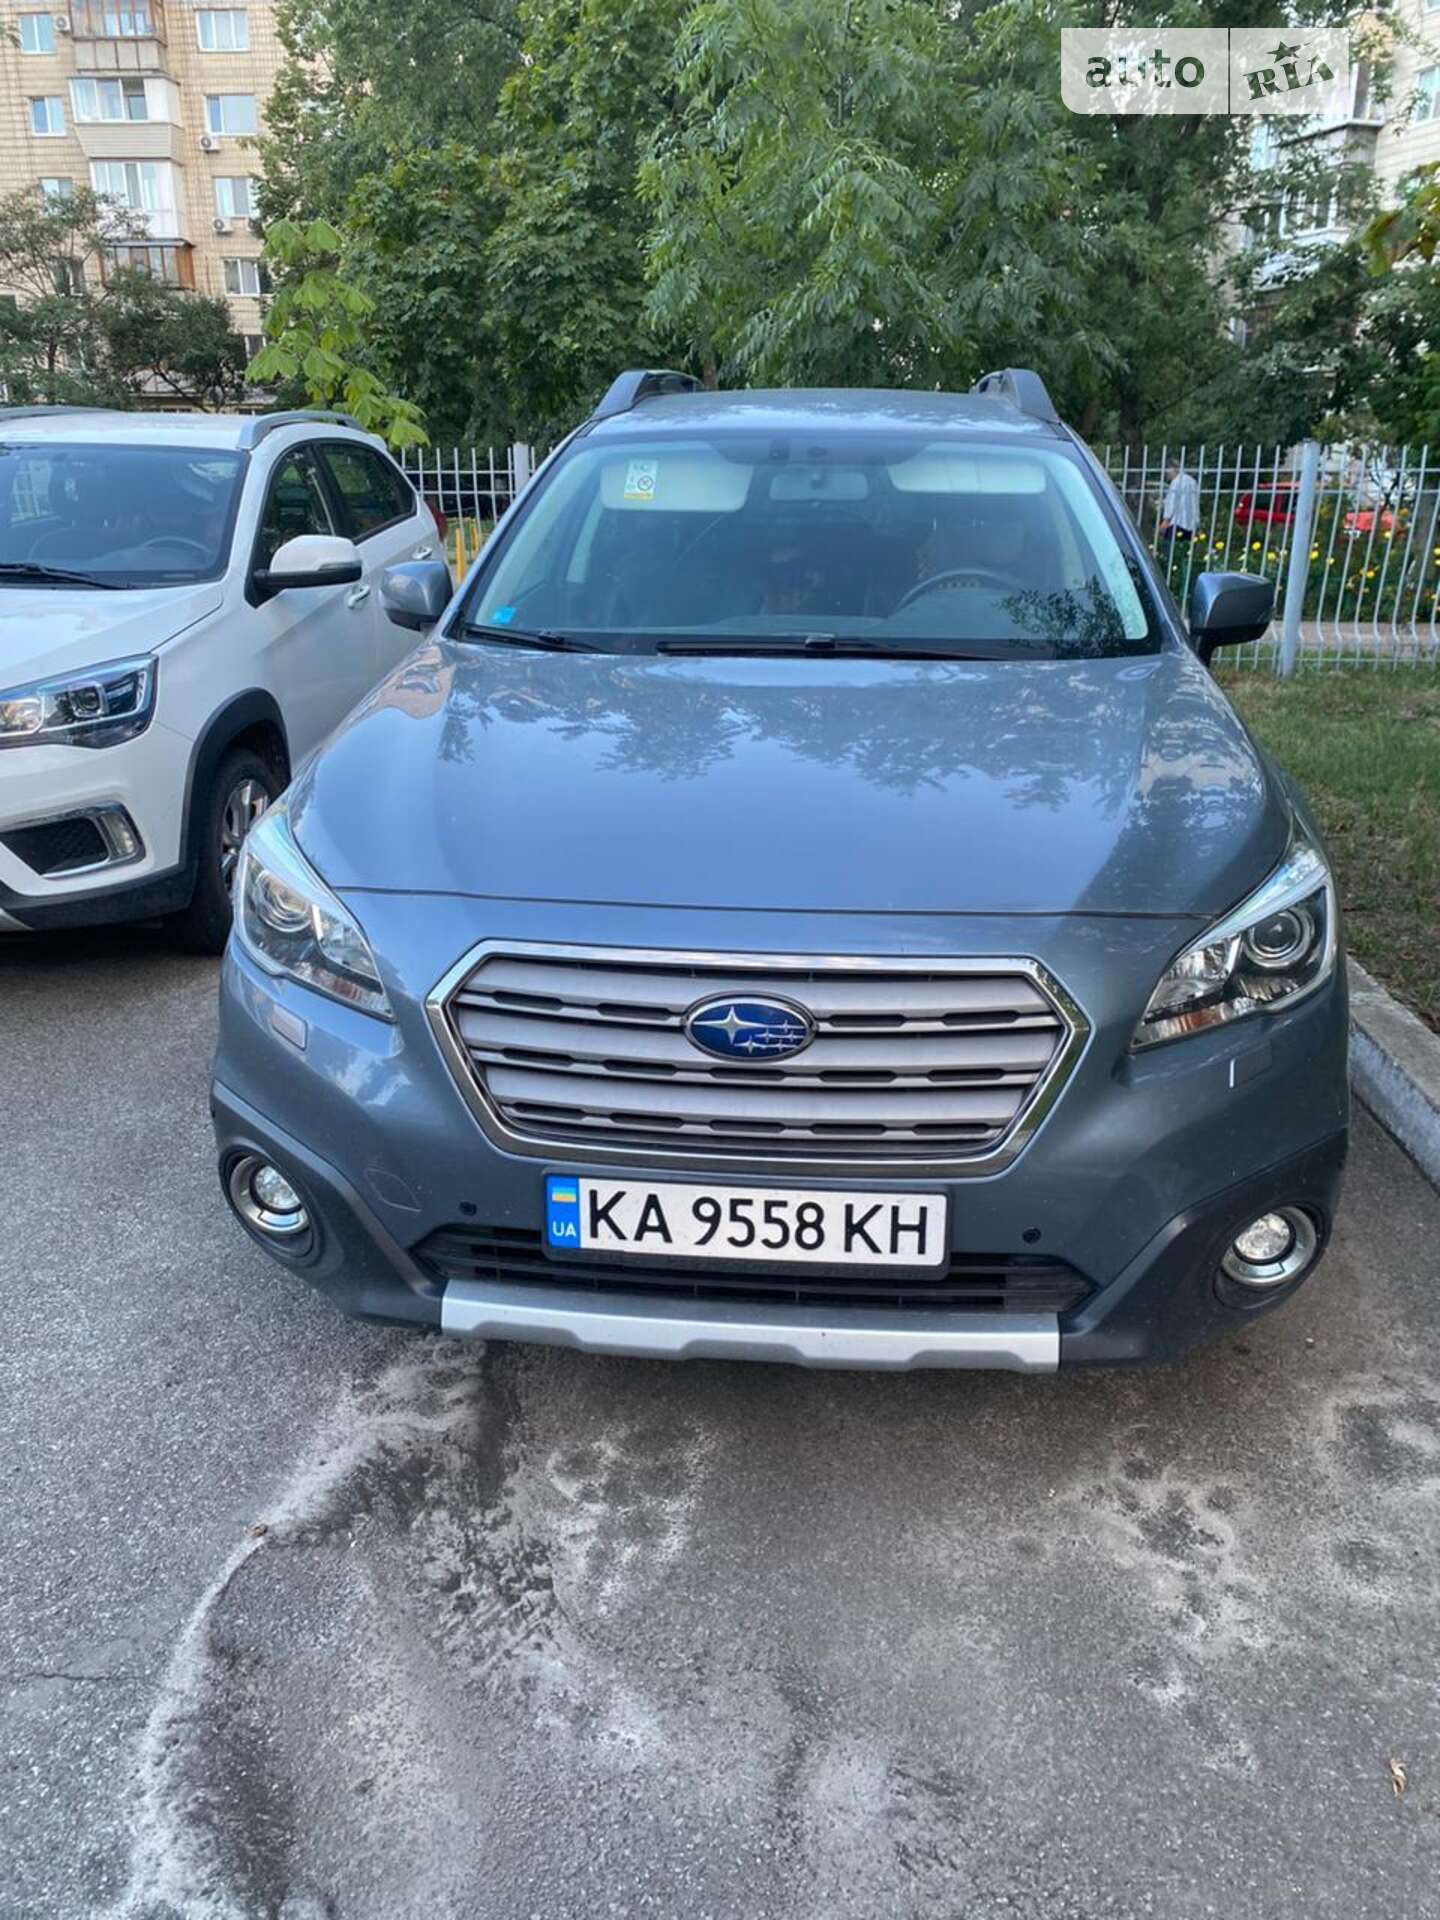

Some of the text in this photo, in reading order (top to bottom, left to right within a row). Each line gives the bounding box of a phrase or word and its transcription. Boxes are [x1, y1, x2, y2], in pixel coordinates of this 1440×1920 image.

[552, 1220, 577, 1238] UA
[588, 1189, 928, 1255] KA 9558 KH
